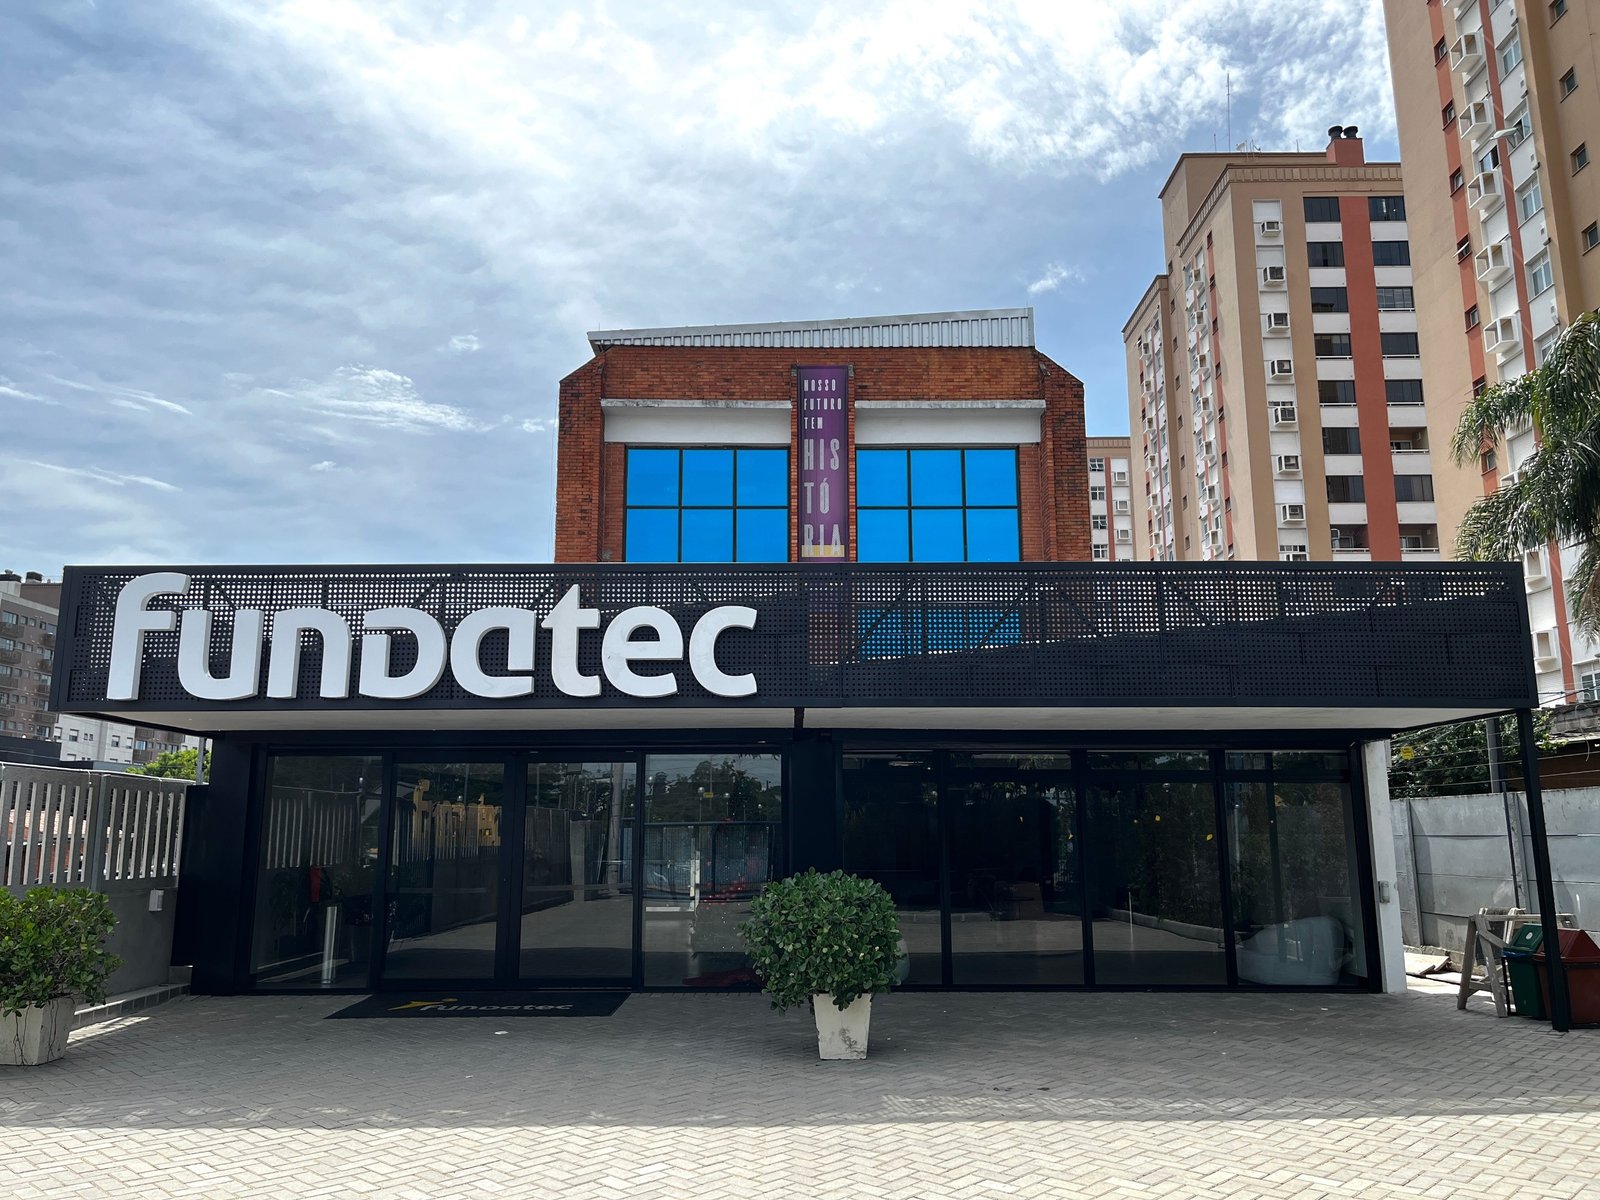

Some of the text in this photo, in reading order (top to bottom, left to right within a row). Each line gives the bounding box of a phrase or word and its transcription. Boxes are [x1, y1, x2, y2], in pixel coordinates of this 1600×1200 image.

[803, 379, 836, 391] NOSSO
[803, 398, 842, 410] FUTURO
[803, 417, 823, 429] TEM
[803, 438, 841, 471] HIS
[803, 478, 830, 514] TÓ
[803, 524, 842, 557] RIA
